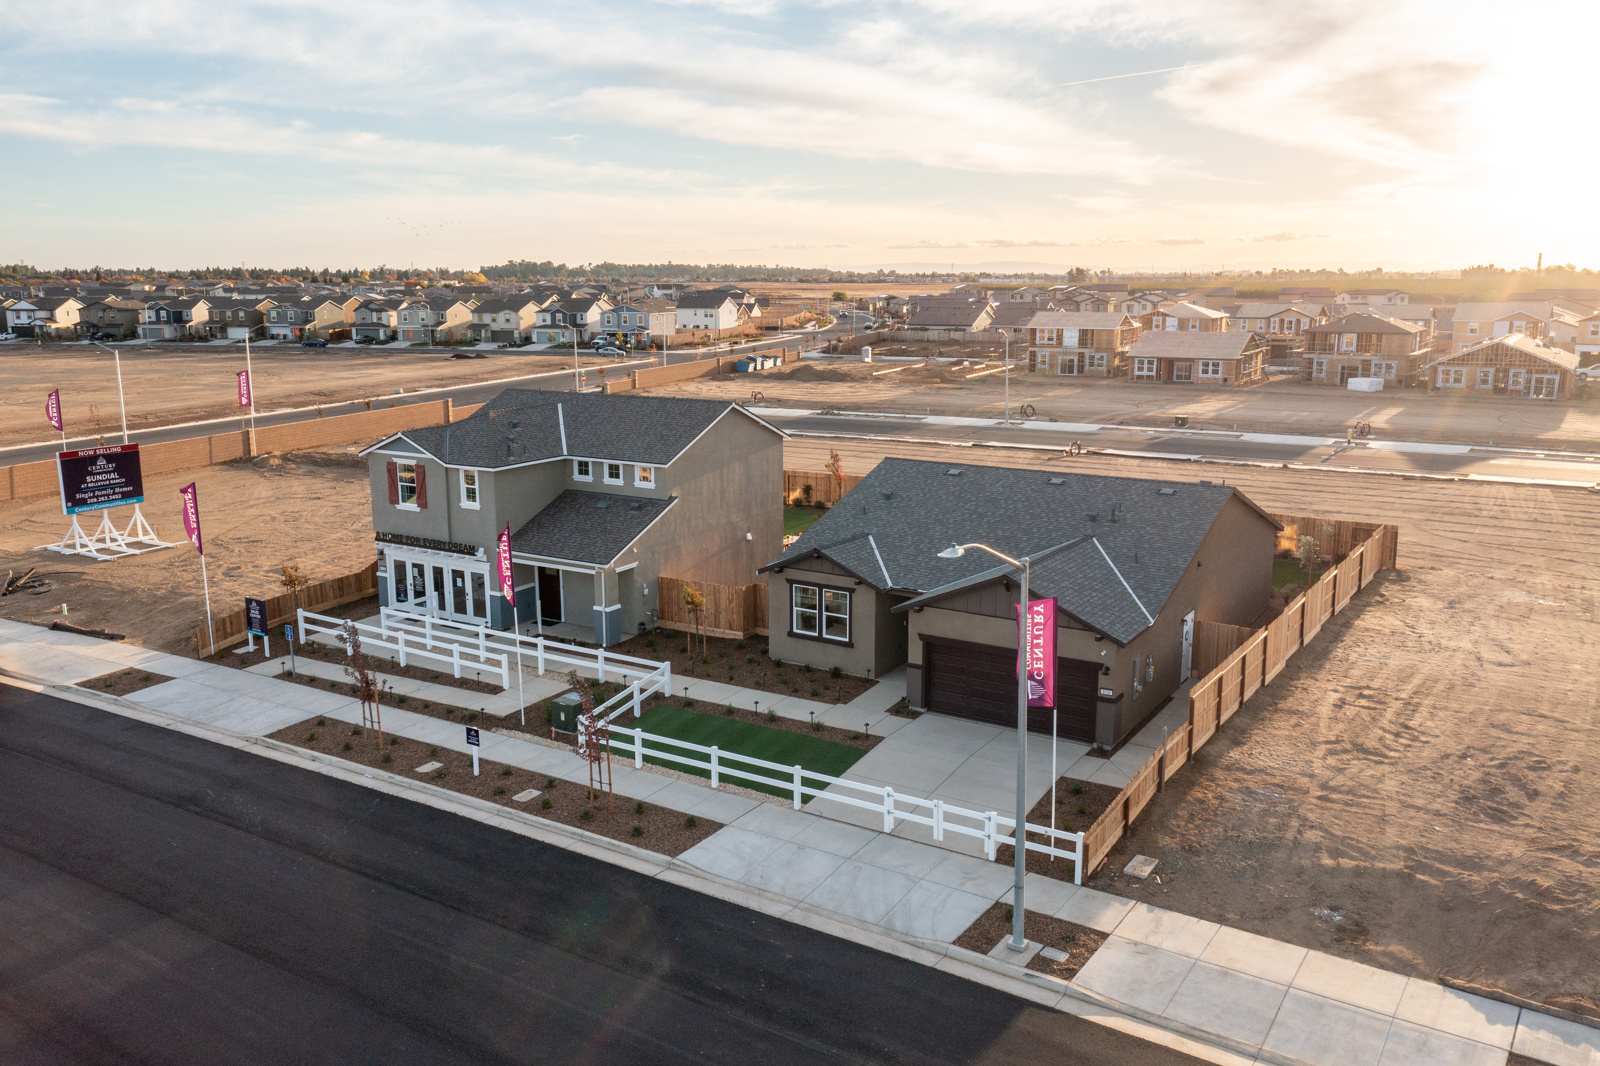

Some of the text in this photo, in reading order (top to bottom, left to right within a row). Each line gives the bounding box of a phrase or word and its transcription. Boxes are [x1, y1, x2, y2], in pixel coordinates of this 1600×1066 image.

[86, 472, 120, 482] SUNDIAL
[75, 485, 133, 499] Single Family Homes
[75, 499, 137, 512] CenturyCommunities.com
[375, 531, 476, 554] A HOME FOR EVERY DREAM
